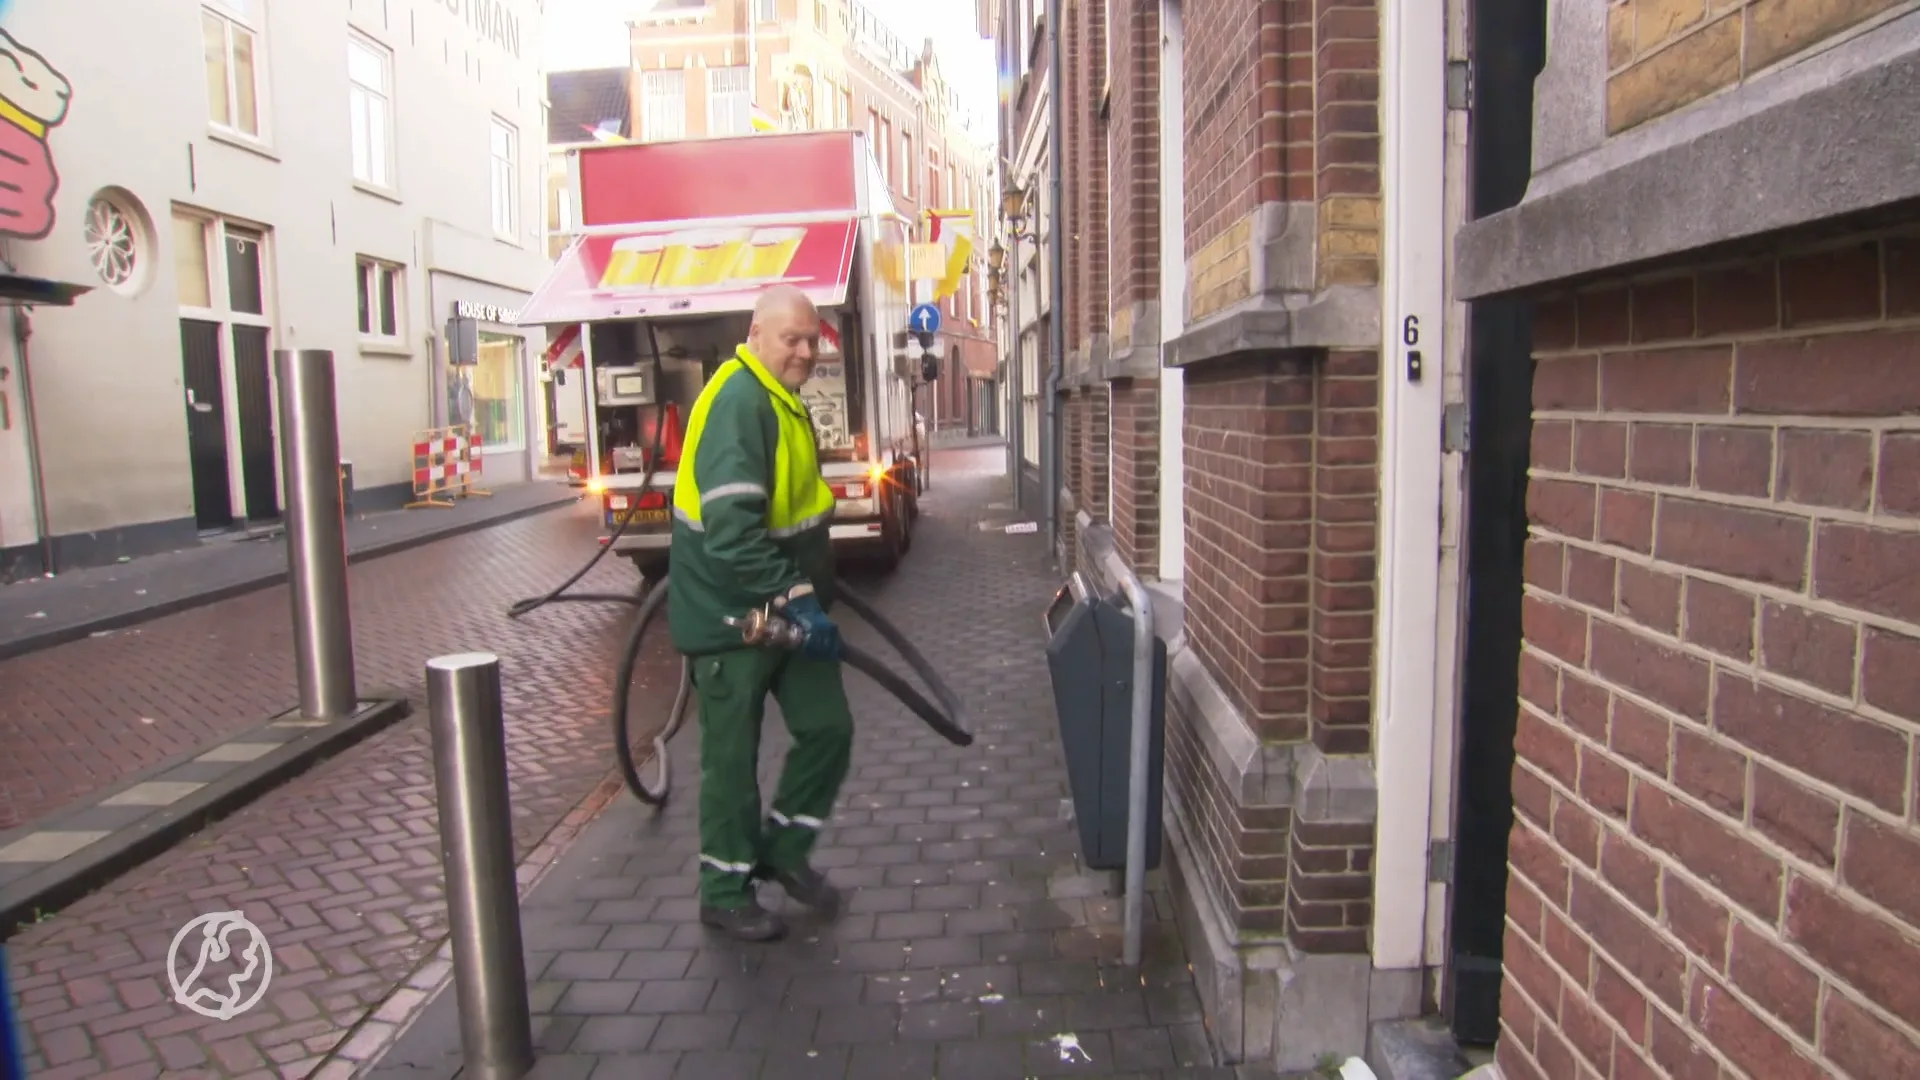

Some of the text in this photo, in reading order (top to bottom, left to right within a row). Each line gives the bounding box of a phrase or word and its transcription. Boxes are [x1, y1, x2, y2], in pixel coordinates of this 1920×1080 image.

[458, 299, 486, 320] HOUSE
[486, 304, 496, 321] OF
[1403, 314, 1419, 346] 6
